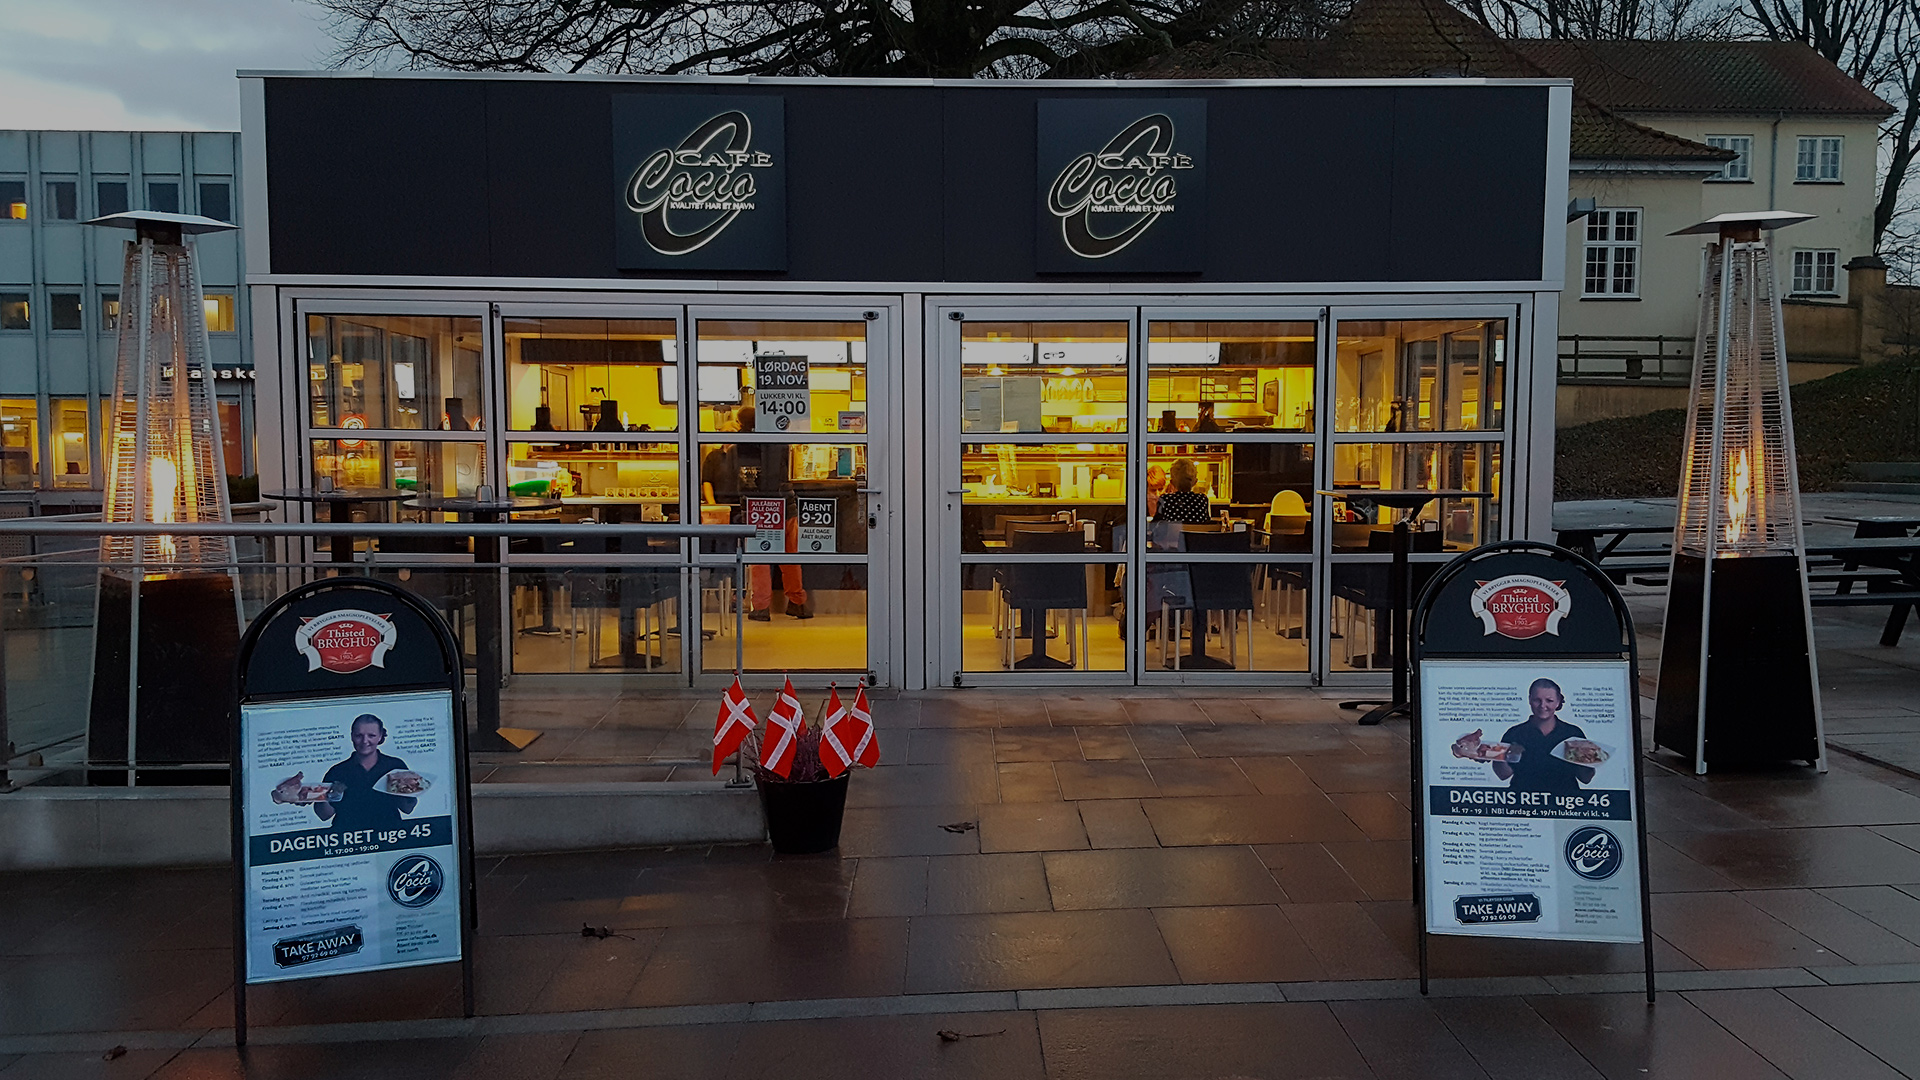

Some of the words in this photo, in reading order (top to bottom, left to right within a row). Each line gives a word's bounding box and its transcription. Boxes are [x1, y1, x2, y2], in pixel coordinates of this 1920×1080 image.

[625, 148, 756, 213] Cocio
[1048, 152, 1177, 217] Cocio
[670, 202, 704, 210] KVALITET
[705, 202, 722, 210] HAR
[722, 202, 732, 210] ET
[732, 202, 755, 210] NAVN
[1091, 204, 1125, 213] KVALITET
[1125, 204, 1141, 213] HAR
[1141, 204, 1151, 213] ET
[1152, 204, 1175, 213] NAVN
[758, 361, 806, 373] LØRDAG
[758, 375, 775, 386] 19.
[777, 374, 806, 386] NOV.
[760, 392, 786, 400] LUKKER
[788, 392, 795, 400] VI
[795, 392, 806, 400] KL.
[759, 400, 807, 415] 14:00
[802, 501, 832, 512] ÅBENT
[750, 512, 781, 525] 9-20
[801, 512, 832, 525] 9-20
[1488, 579, 1512, 590] BRYGGER
[1511, 578, 1560, 596] SMAGSOPLEVELSER
[1501, 594, 1539, 603] Thisted
[1492, 603, 1551, 613] BRYGHUS
[313, 614, 337, 626] BRYGGER
[327, 628, 365, 638] Thisted
[318, 637, 376, 649] BRYGHUS
[1450, 790, 1517, 805] DAGENS
[1520, 791, 1552, 806] RET
[1555, 796, 1585, 810] uge
[1587, 793, 1611, 807] 46
[1505, 807, 1531, 816] Lørdag
[270, 833, 339, 853] DAGENS
[343, 829, 374, 845] RET
[378, 829, 407, 844] uge
[410, 823, 431, 838] 45
[334, 847, 354, 855] 17:00
[359, 844, 379, 852] 19:00
[1571, 843, 1610, 860] Cocio
[393, 872, 432, 892] Cocio
[1461, 904, 1494, 915] TAKE
[1495, 902, 1534, 914] AWAY
[281, 942, 315, 958] TAKE
[317, 933, 355, 952] AWAY
[329, 948, 338, 956] 09
